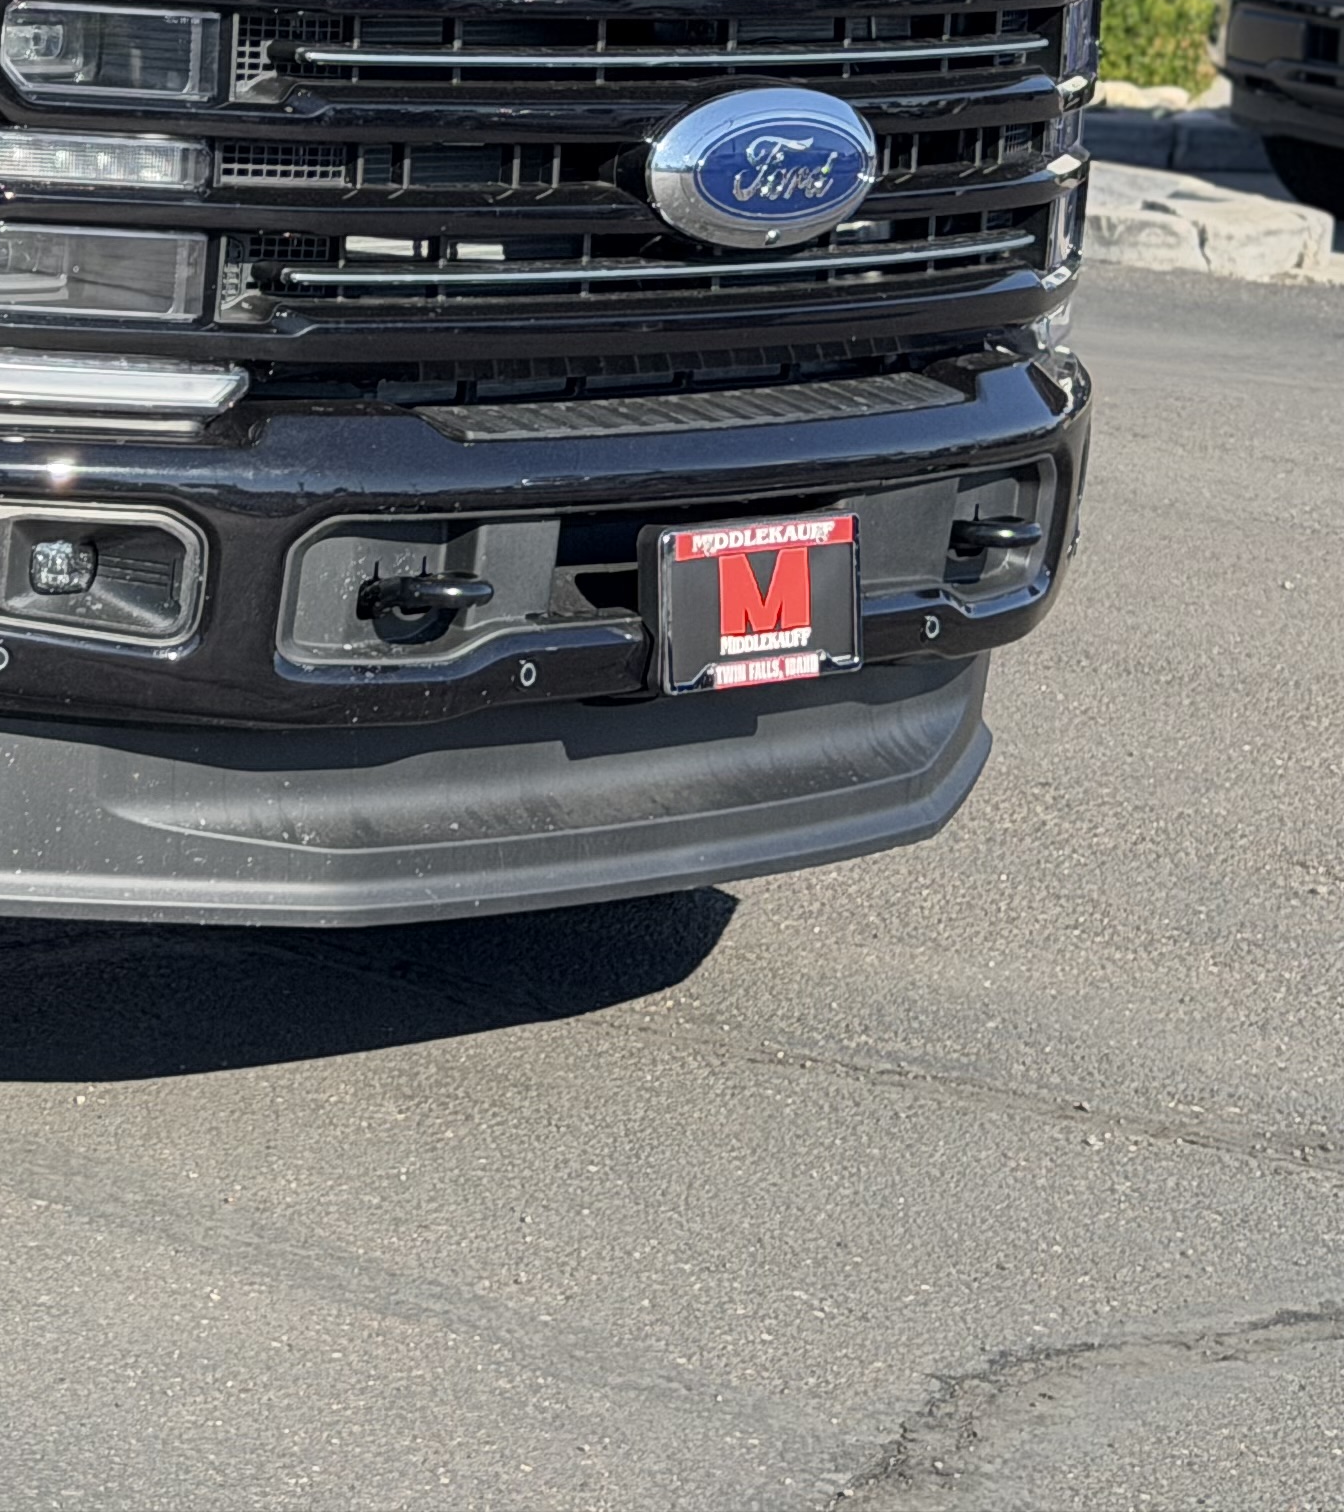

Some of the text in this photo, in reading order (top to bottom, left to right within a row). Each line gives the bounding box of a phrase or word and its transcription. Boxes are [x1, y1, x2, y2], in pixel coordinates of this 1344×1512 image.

[732, 135, 838, 202] Ford
[691, 520, 836, 555] MIDDLEKAUFF
[718, 546, 811, 636] M
[719, 627, 812, 656] MIDDLEKAUFF
[714, 663, 748, 685] TWIN
[785, 653, 820, 676] IDAHO
